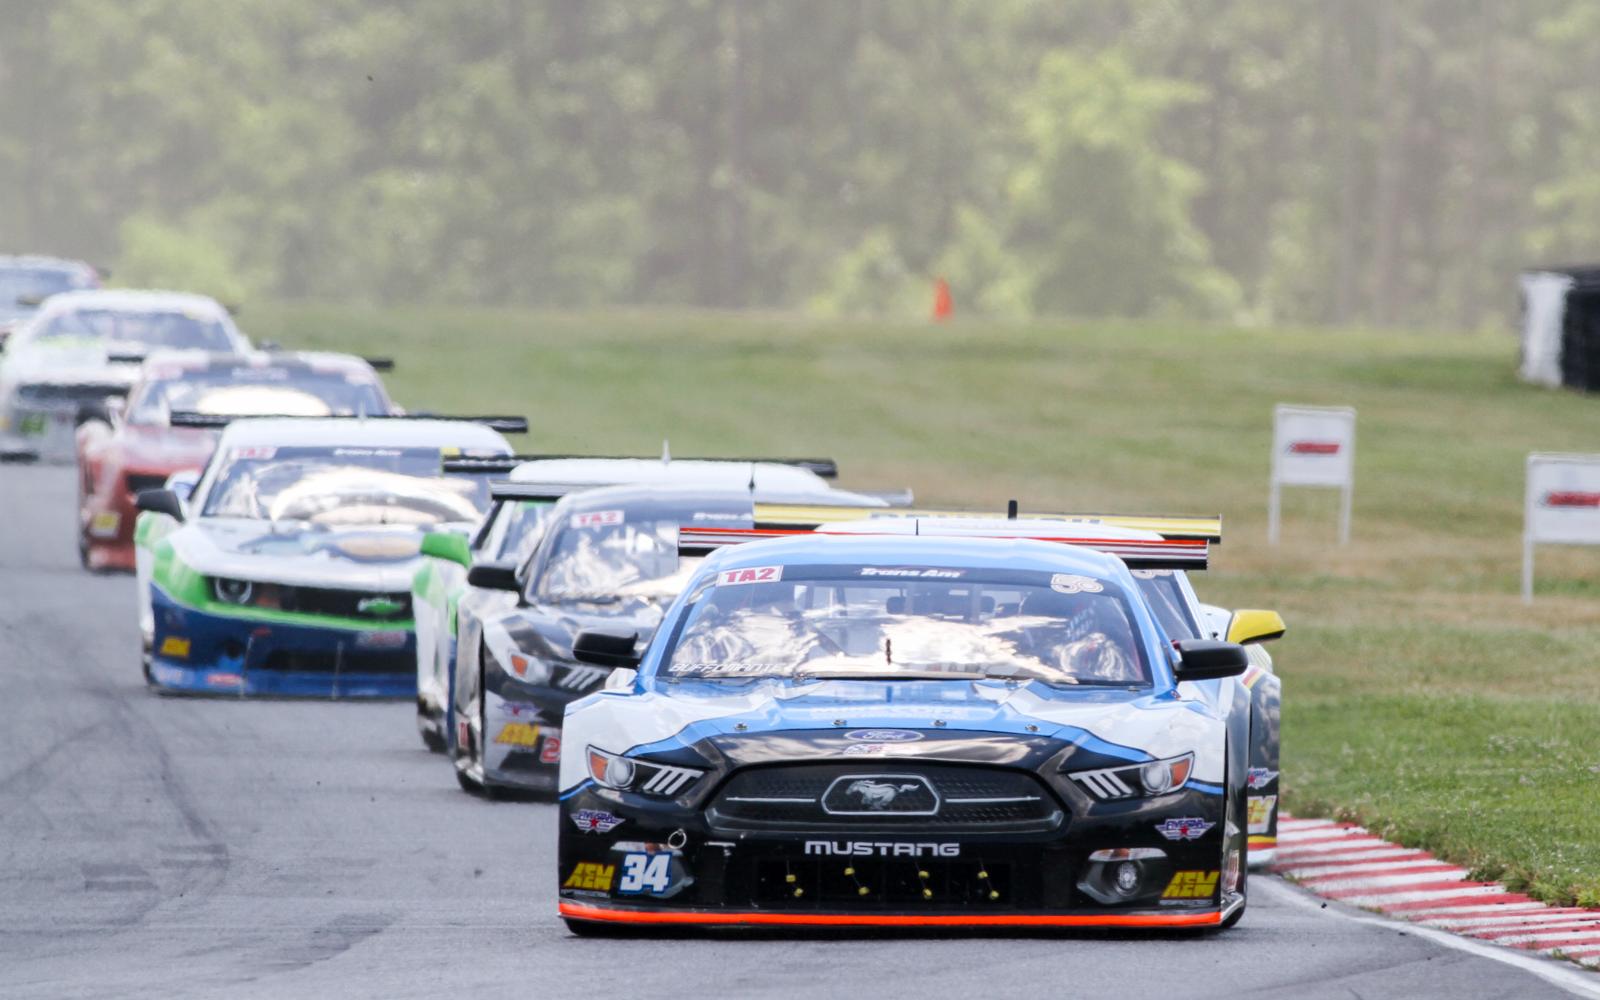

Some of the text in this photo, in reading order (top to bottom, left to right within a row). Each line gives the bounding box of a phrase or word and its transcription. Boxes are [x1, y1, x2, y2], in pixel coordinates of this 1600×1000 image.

[725, 567, 775, 583] TA2
[861, 567, 961, 579] Trans Am
[862, 731, 907, 740] Ford
[804, 840, 961, 857] MUSTANG
[562, 862, 616, 891] AEM
[619, 852, 672, 893] 34
[1161, 869, 1221, 898] AEM
